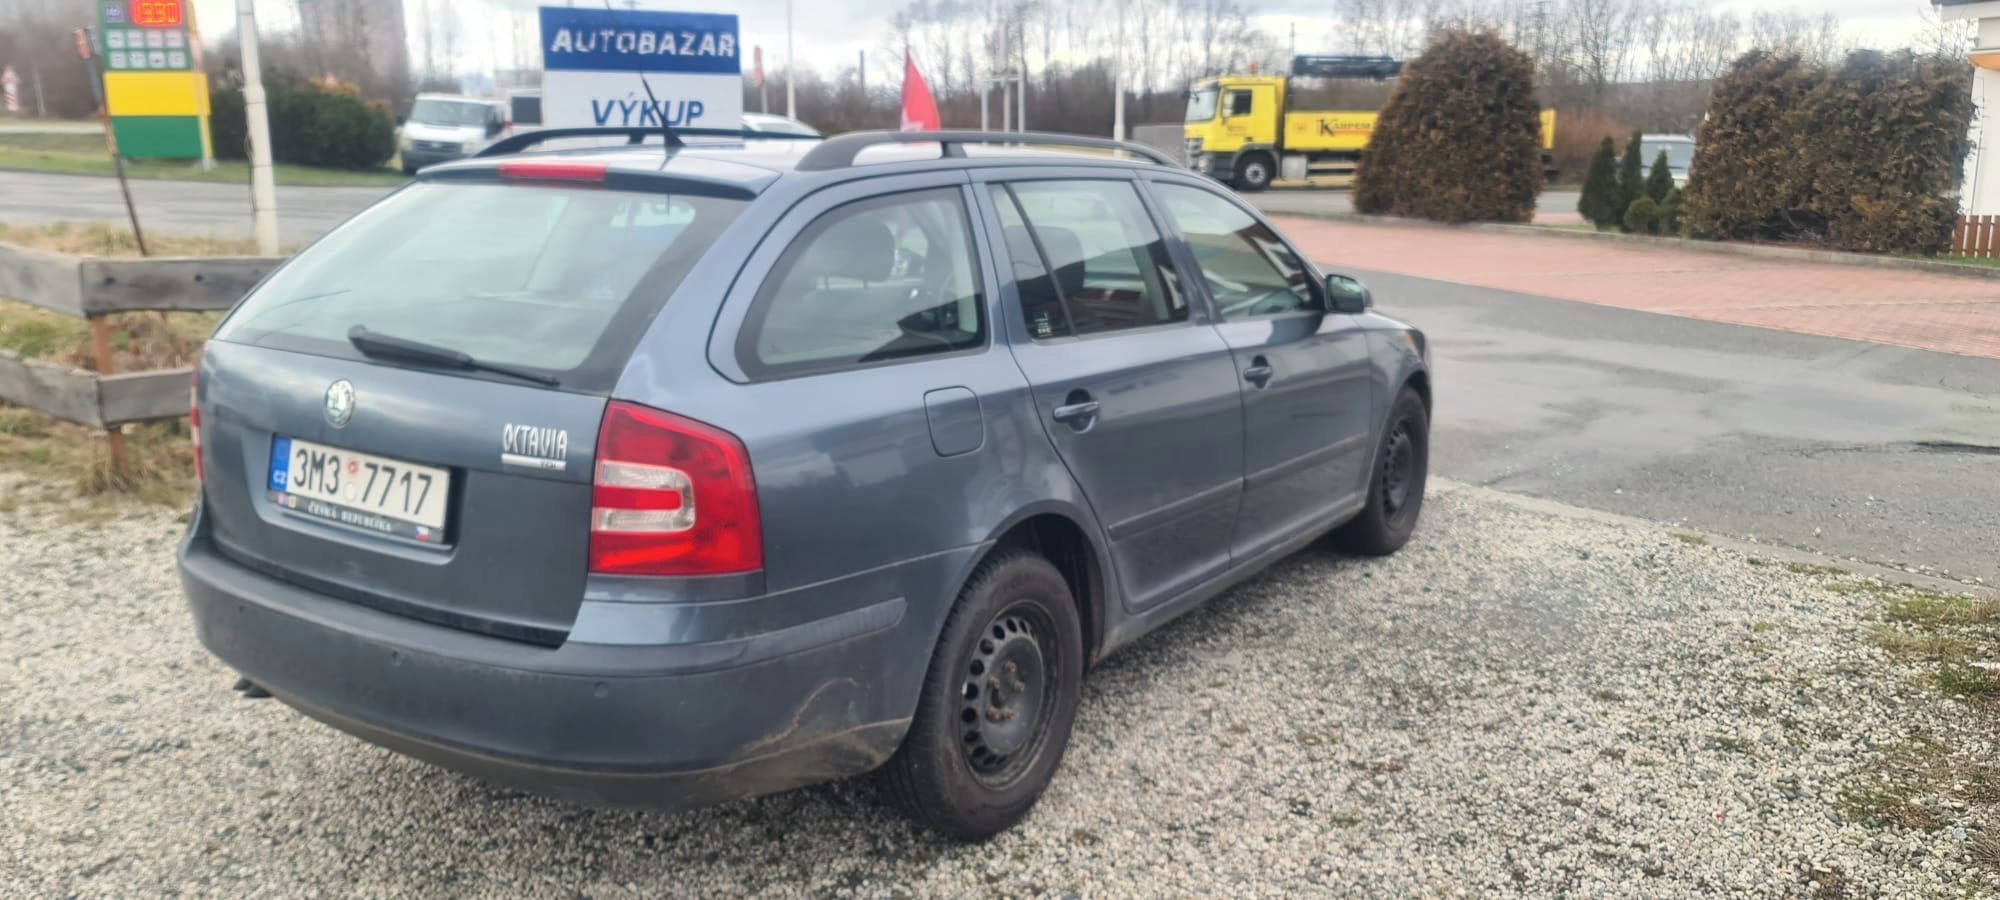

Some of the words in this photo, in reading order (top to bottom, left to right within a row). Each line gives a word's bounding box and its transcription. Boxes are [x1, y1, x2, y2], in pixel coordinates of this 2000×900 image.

[552, 28, 735, 57] AUTOBAZAR
[592, 91, 704, 126] VÝKUP
[503, 423, 568, 460] OCTAVIA
[273, 470, 286, 484] CZ
[294, 448, 340, 495] 3M3
[361, 462, 432, 516] 7717
